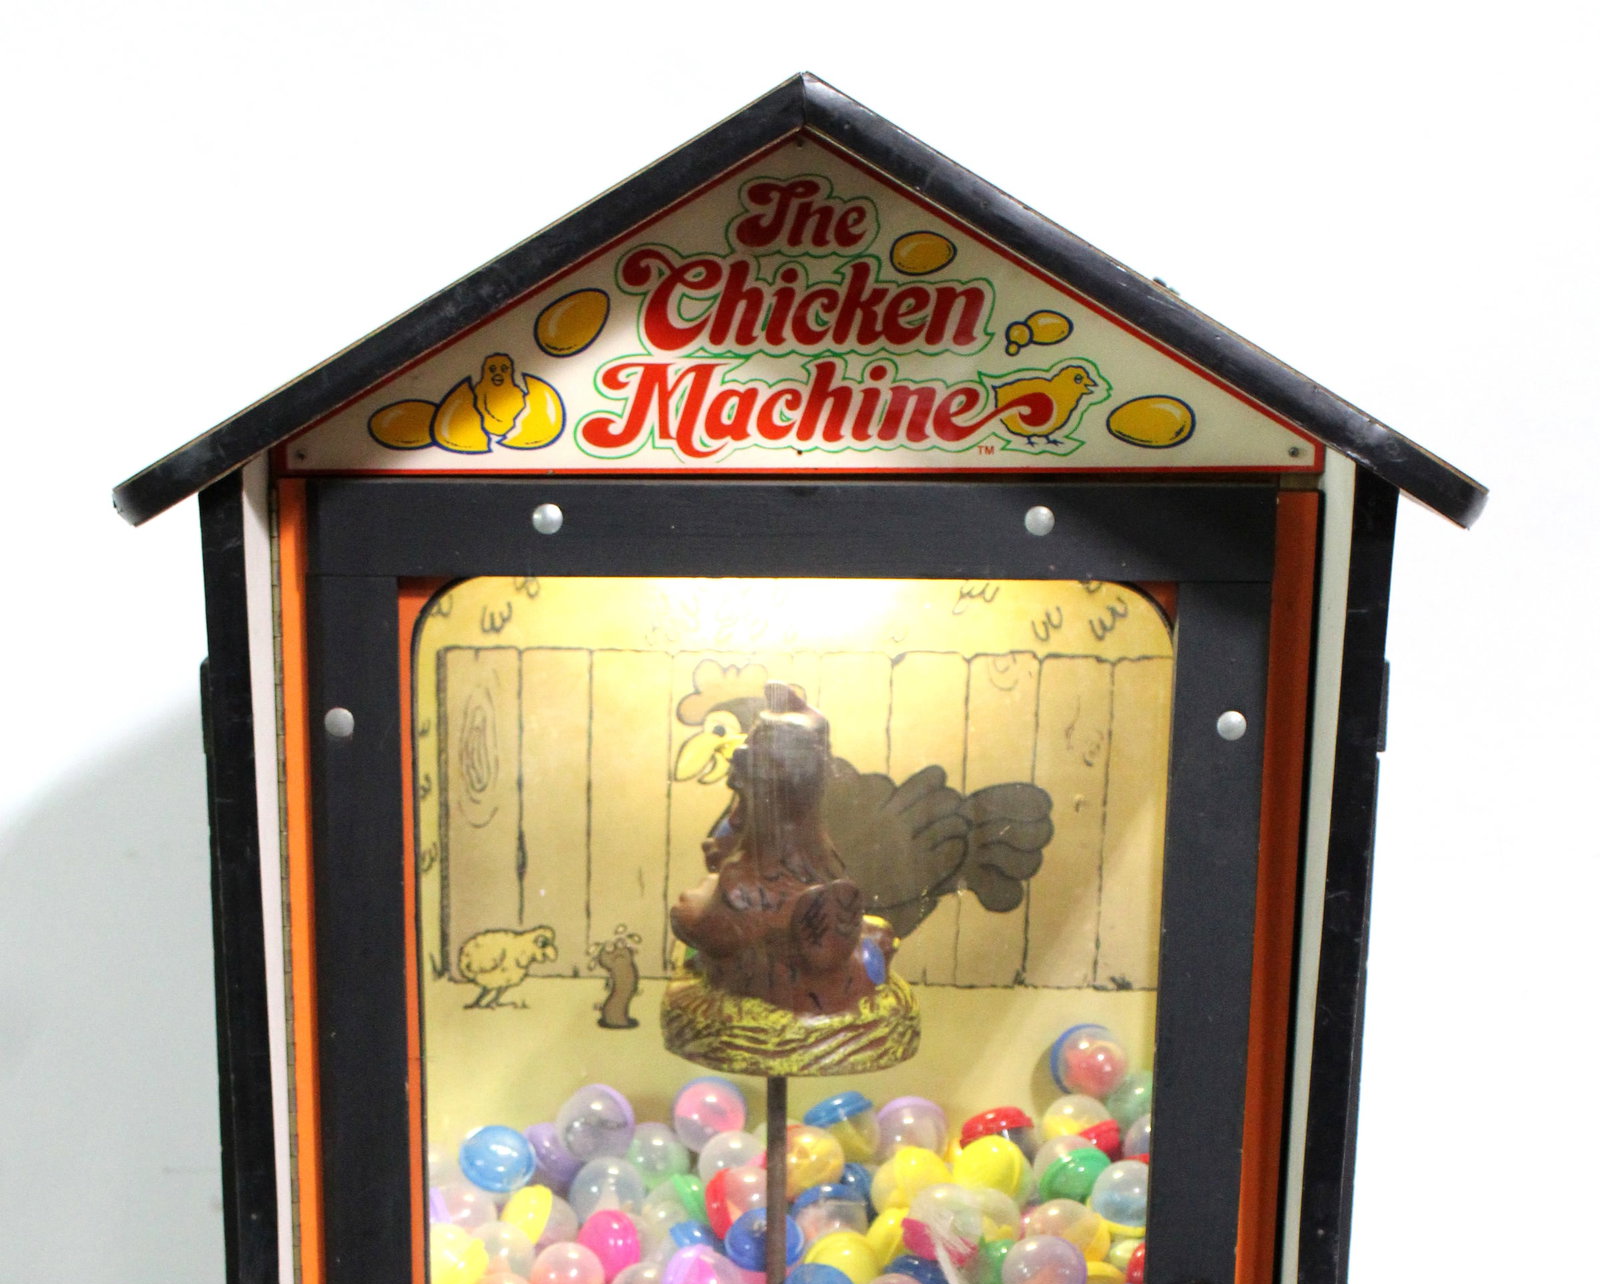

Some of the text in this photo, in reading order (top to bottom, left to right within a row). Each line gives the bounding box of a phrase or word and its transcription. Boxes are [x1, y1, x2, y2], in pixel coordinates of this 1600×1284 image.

[736, 180, 866, 247] The
[622, 249, 986, 352] Chicken
[582, 358, 1054, 459] Machine
